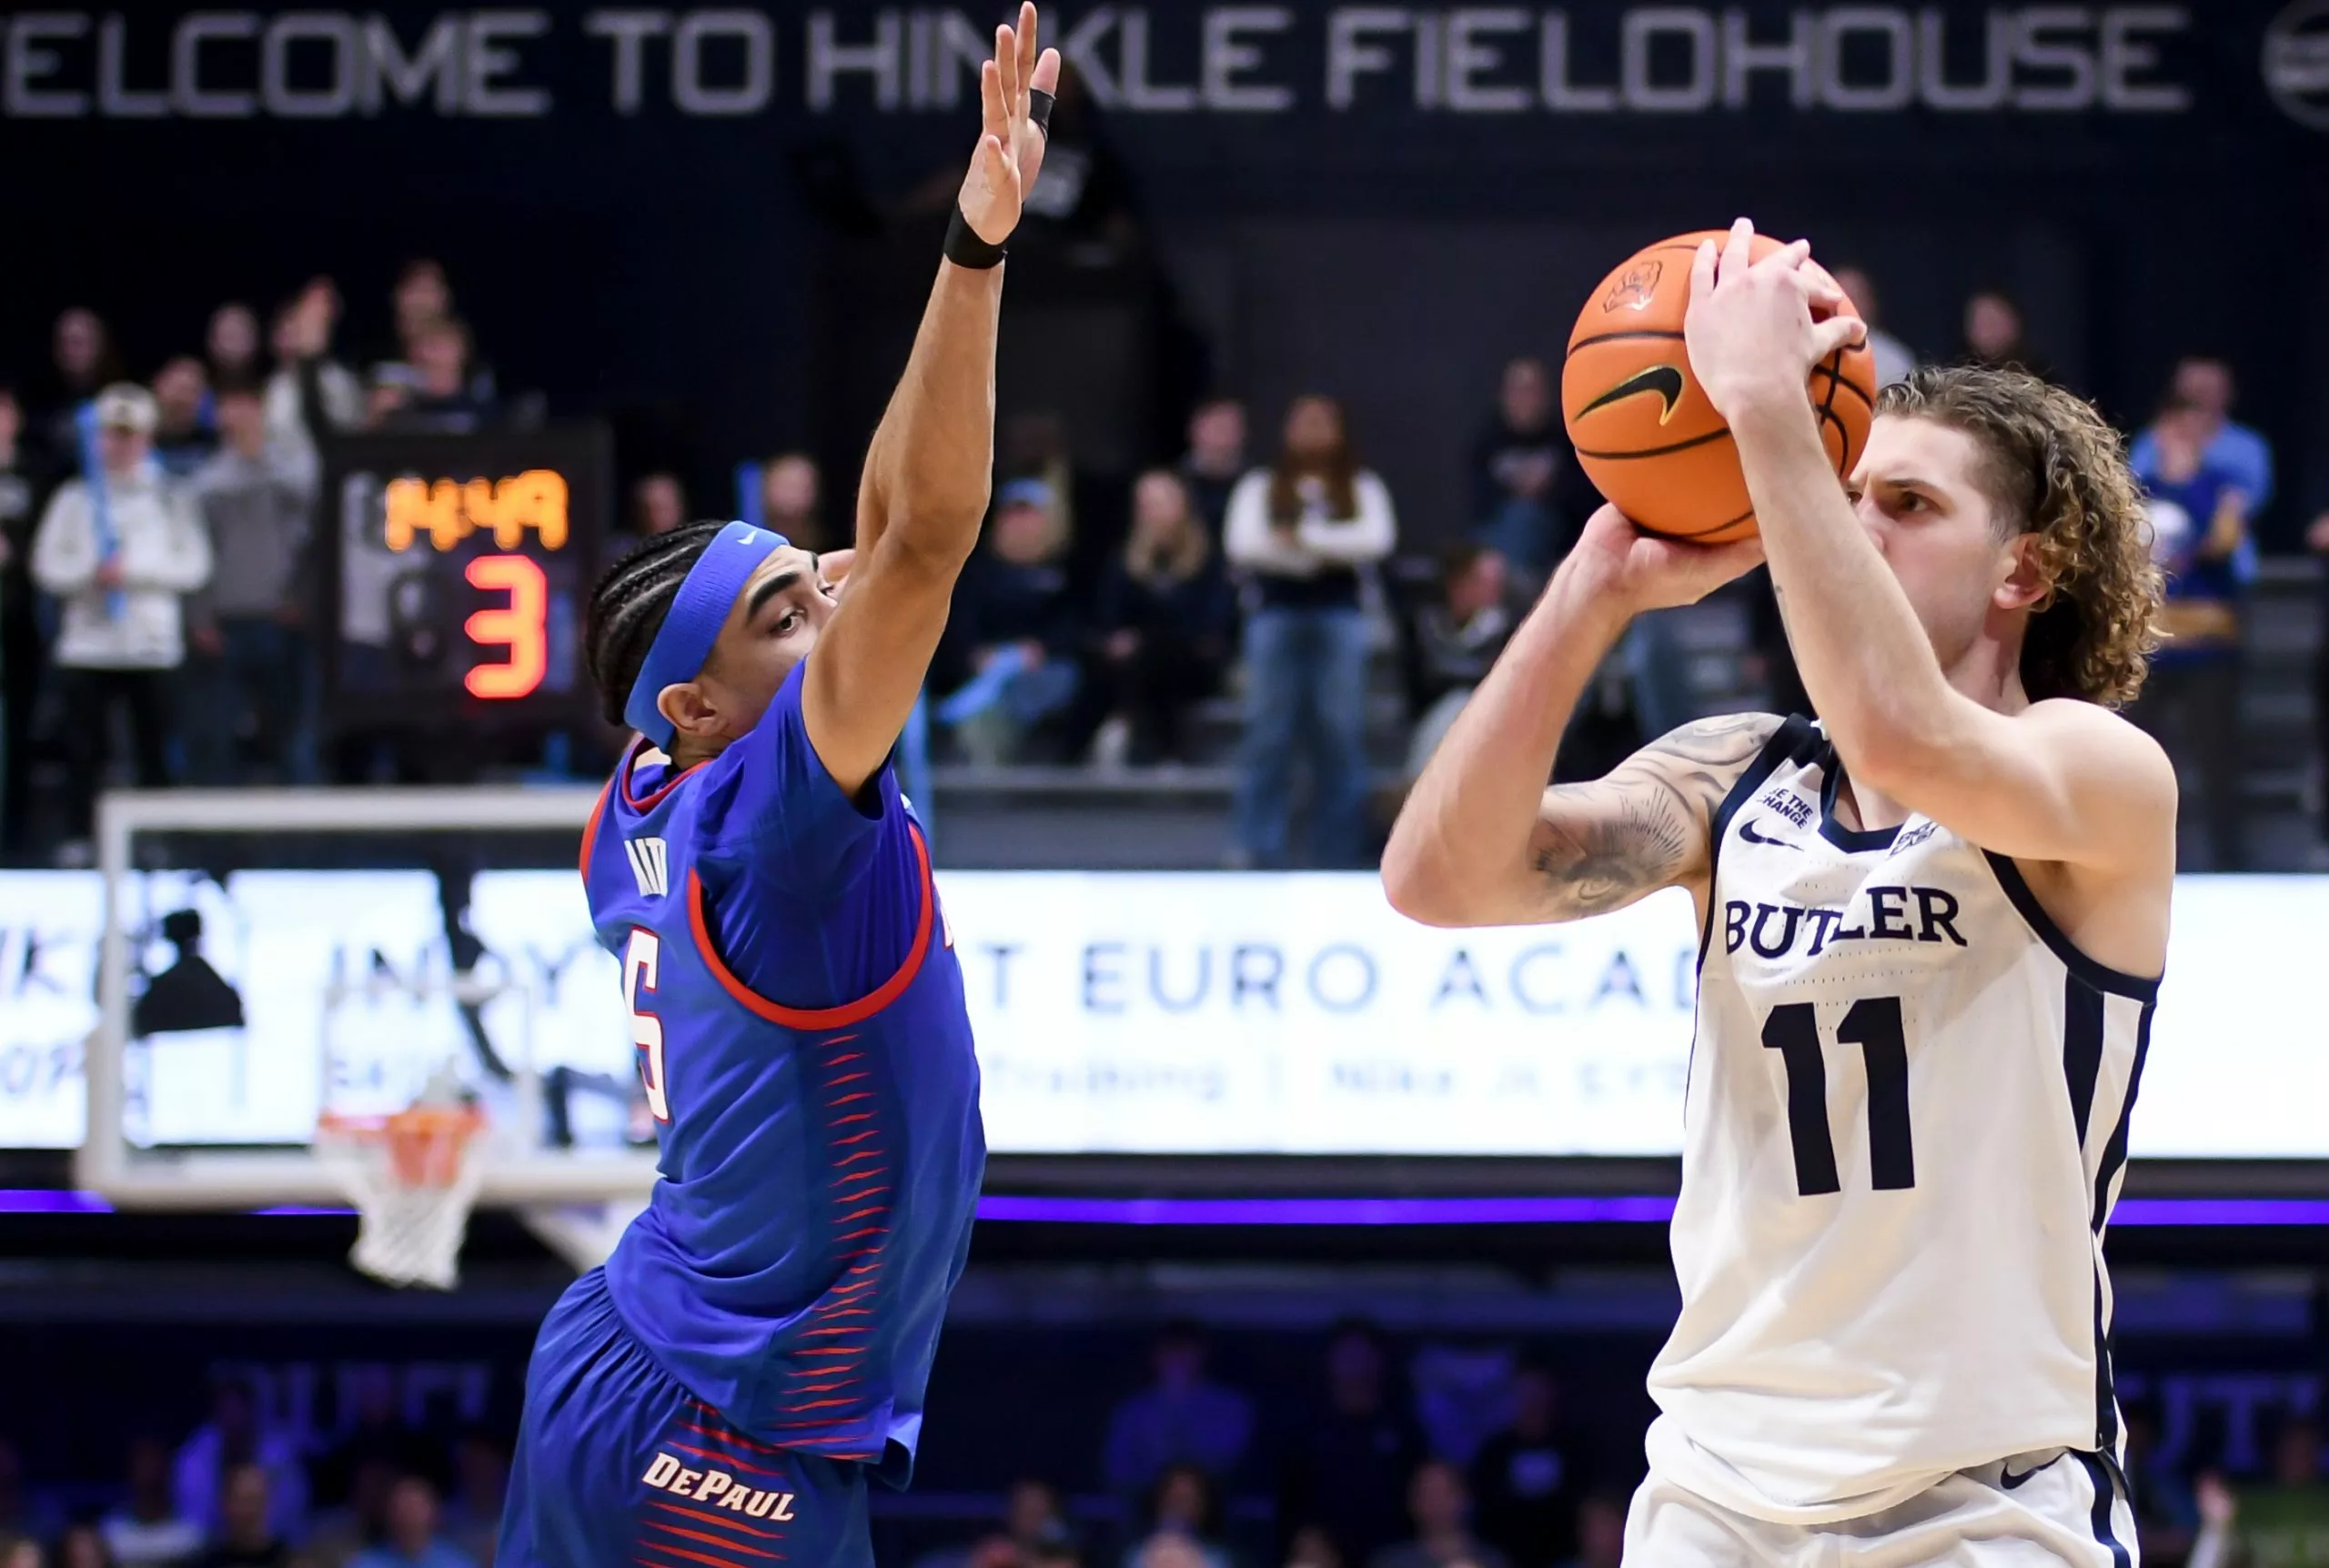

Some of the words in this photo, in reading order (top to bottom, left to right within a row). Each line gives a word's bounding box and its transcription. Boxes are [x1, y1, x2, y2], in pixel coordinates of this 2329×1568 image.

[0, 11, 549, 116] ELCOME
[587, 10, 773, 114] TO
[806, 8, 1295, 111] HINKLE
[1325, 8, 2193, 112] FIELDHOUSE
[464, 554, 547, 699] 3
[1756, 795, 1808, 830] HANGE
[1788, 793, 1813, 819] THE
[1081, 941, 1381, 1014] EURO
[1760, 995, 1915, 1197] 11
